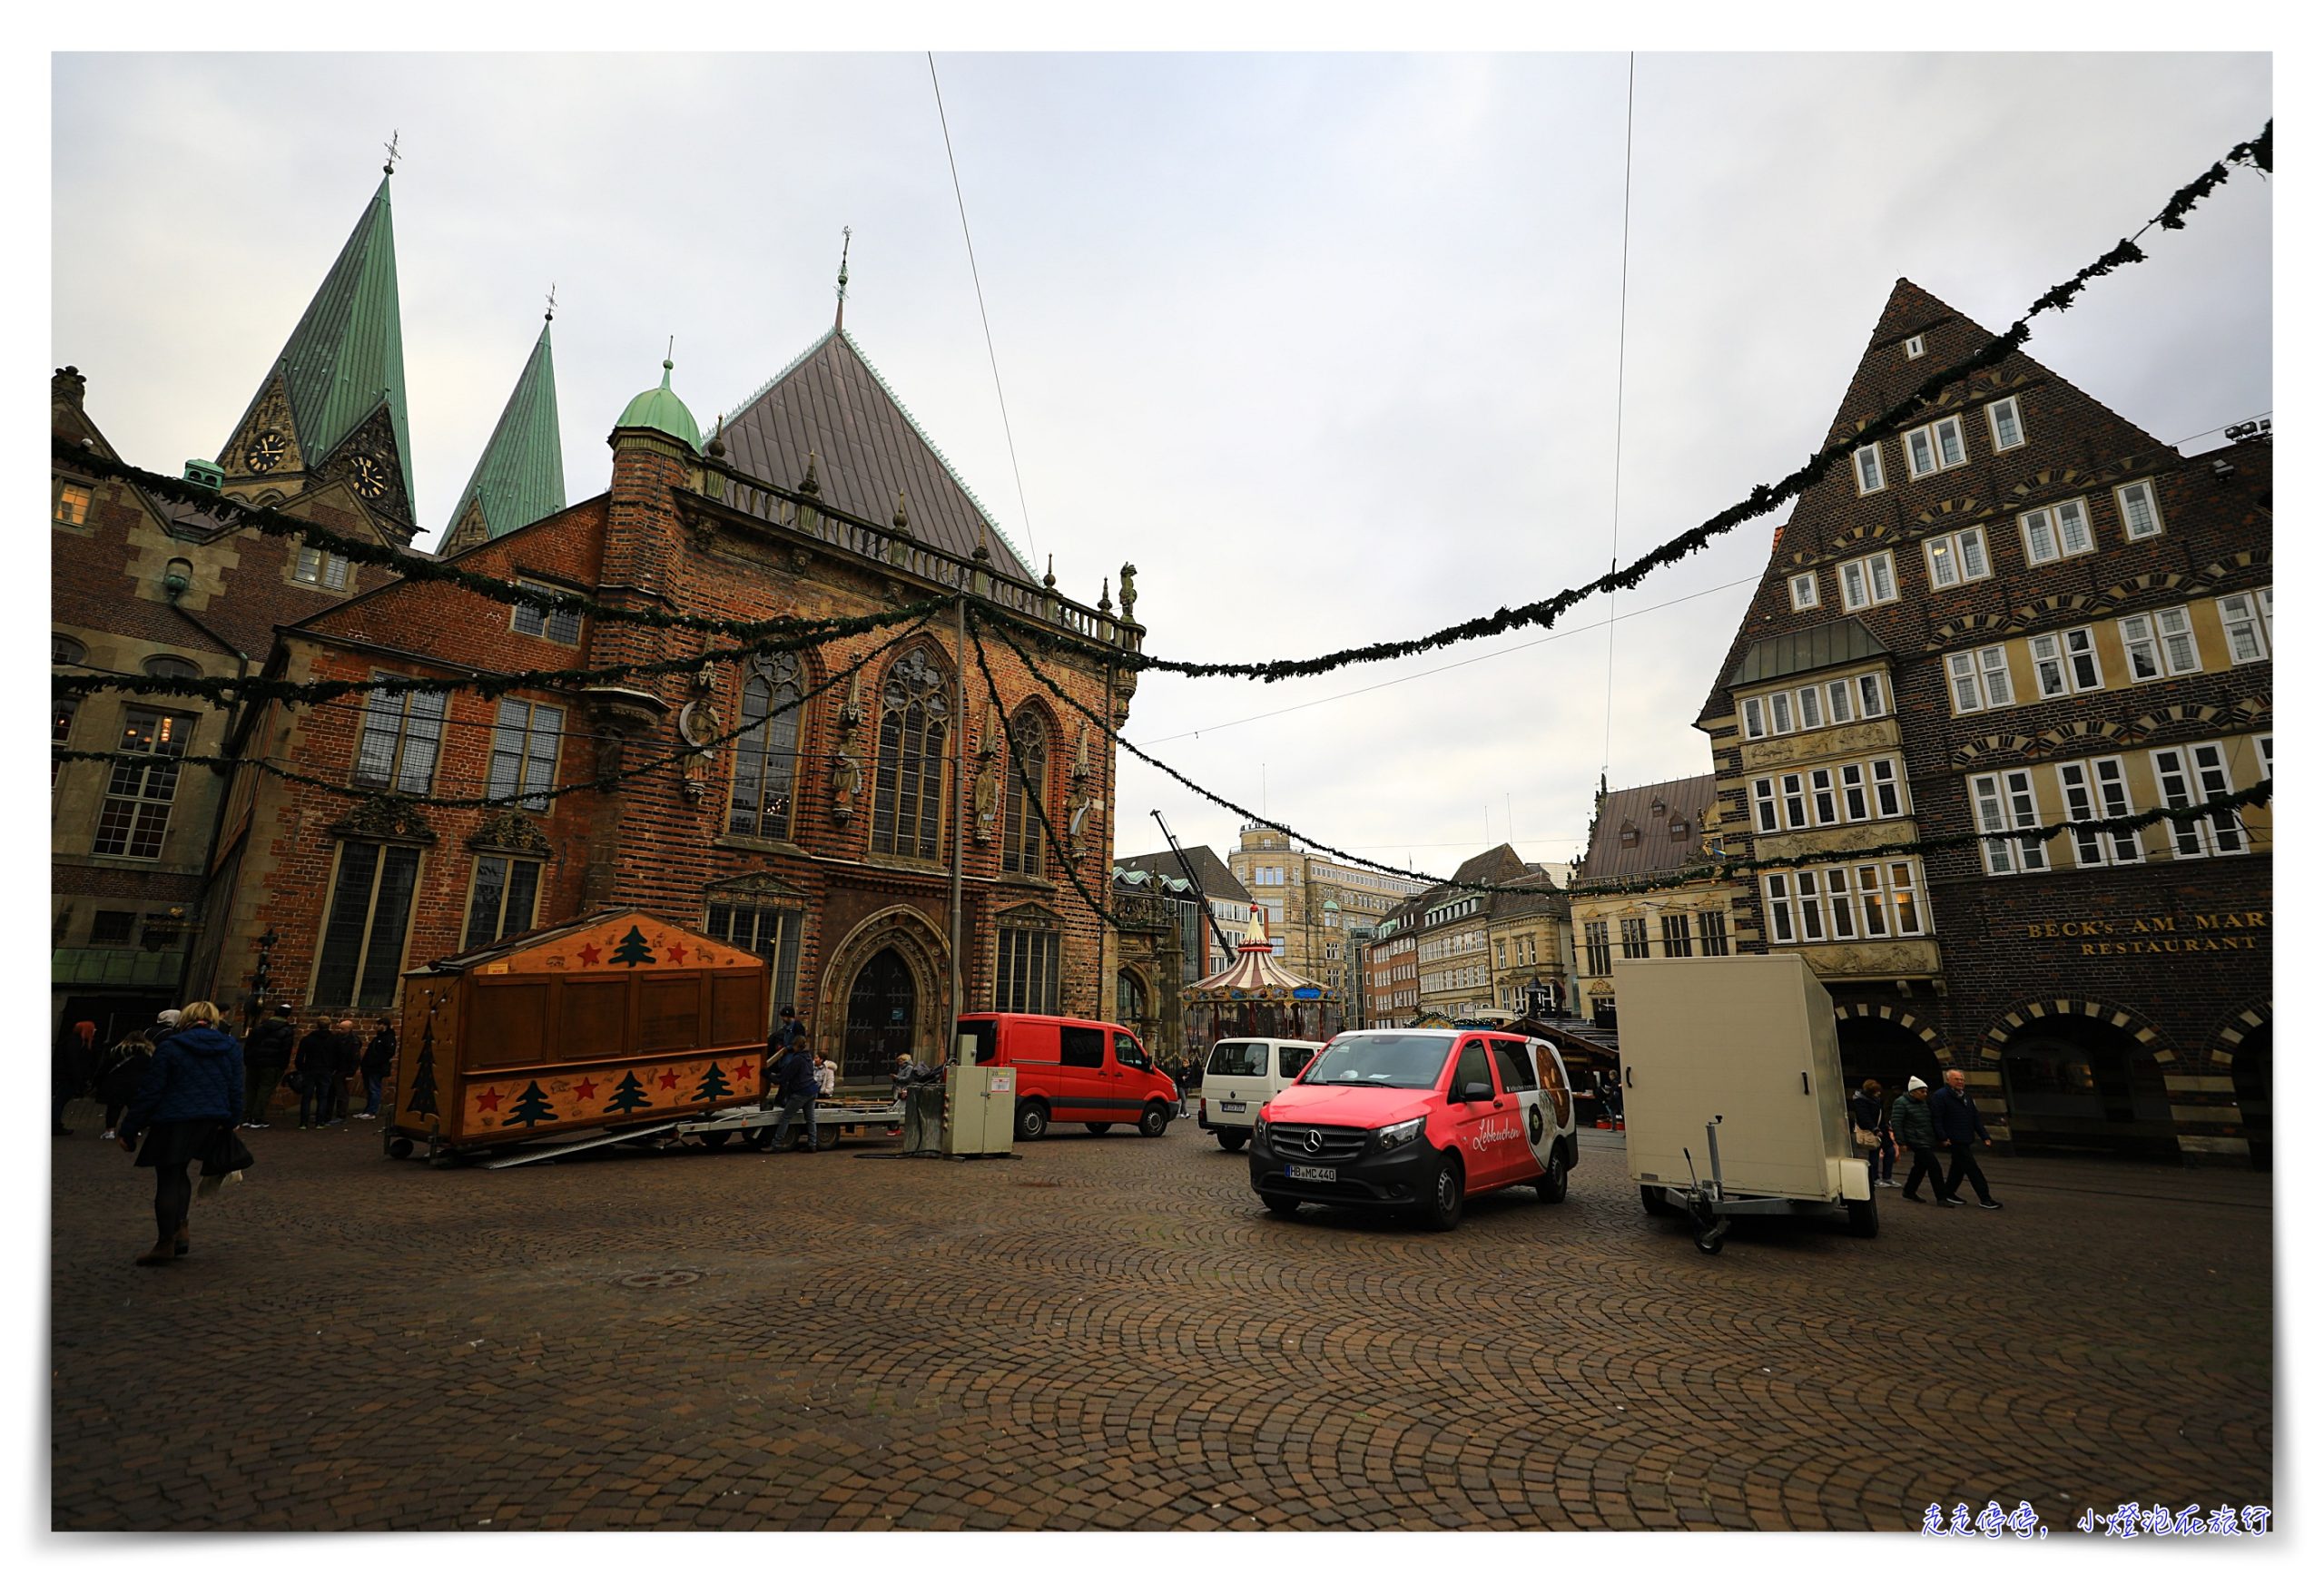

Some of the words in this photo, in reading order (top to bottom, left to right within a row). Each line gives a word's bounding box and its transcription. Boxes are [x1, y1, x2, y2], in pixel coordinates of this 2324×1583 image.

[2027, 920, 2114, 938] BECK's
[2132, 917, 2176, 932] AM
[2081, 936, 2258, 956] RESTAURANT
[1472, 1117, 1521, 1152] Lebkuchen
[1290, 1165, 1301, 1177] HB
[1305, 1167, 1317, 1179] MC
[1318, 1169, 1334, 1180] 440
